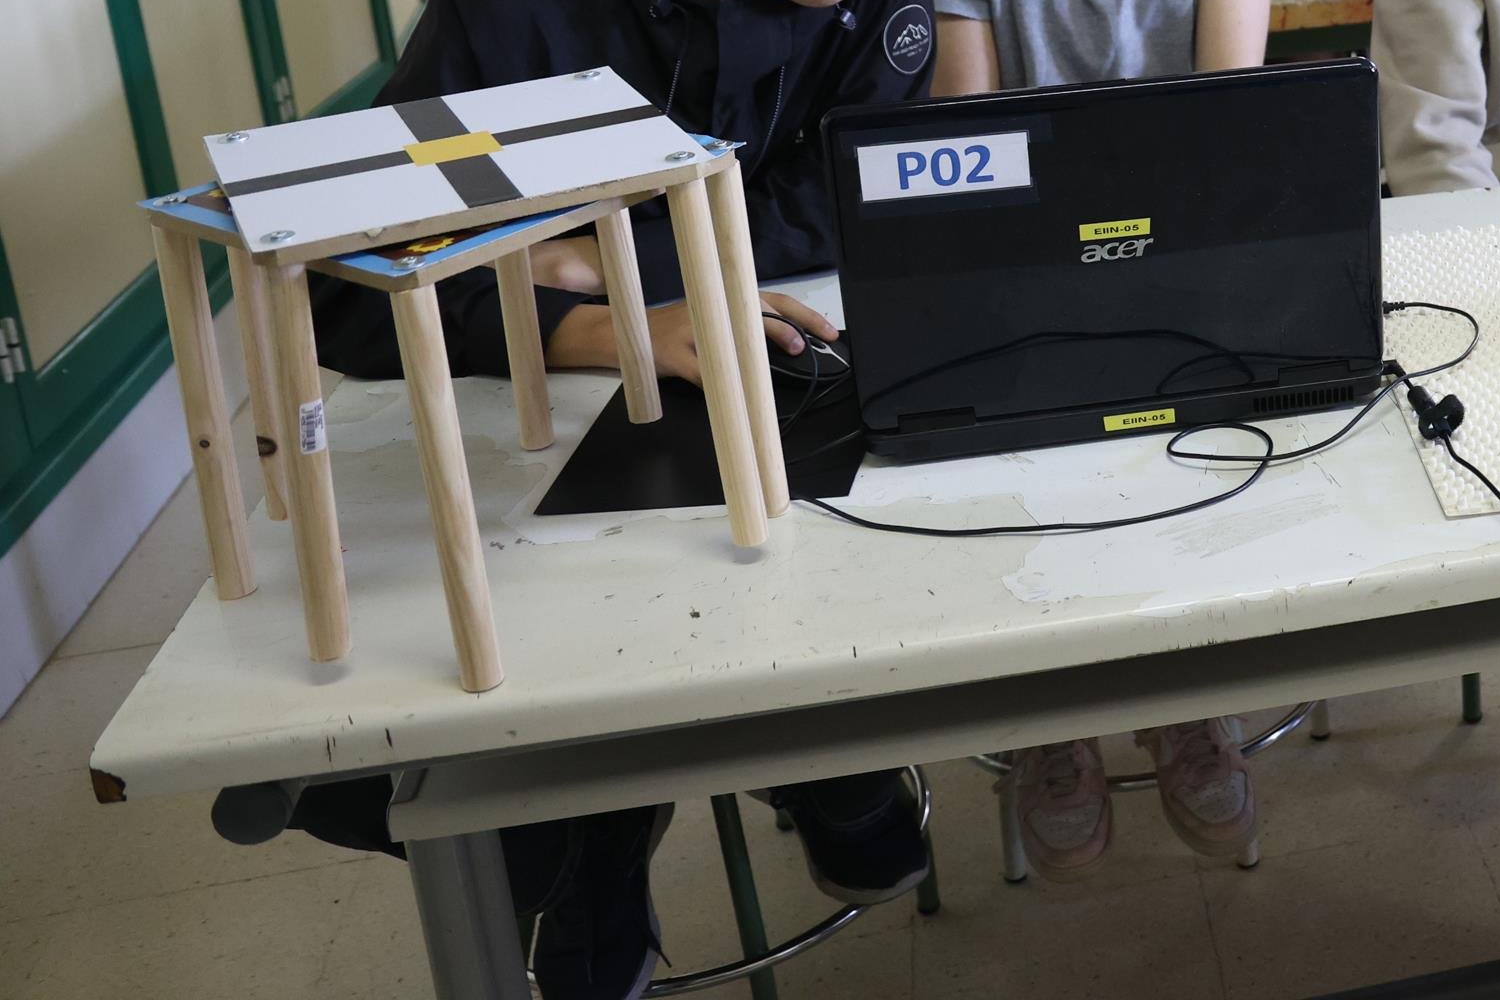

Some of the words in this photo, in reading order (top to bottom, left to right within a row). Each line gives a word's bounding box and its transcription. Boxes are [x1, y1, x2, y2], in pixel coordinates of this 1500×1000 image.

[896, 144, 994, 190] P02
[1094, 224, 1140, 235] EIIN-05
[1080, 238, 1154, 263] acer
[1122, 414, 1166, 425] EIIN-05
